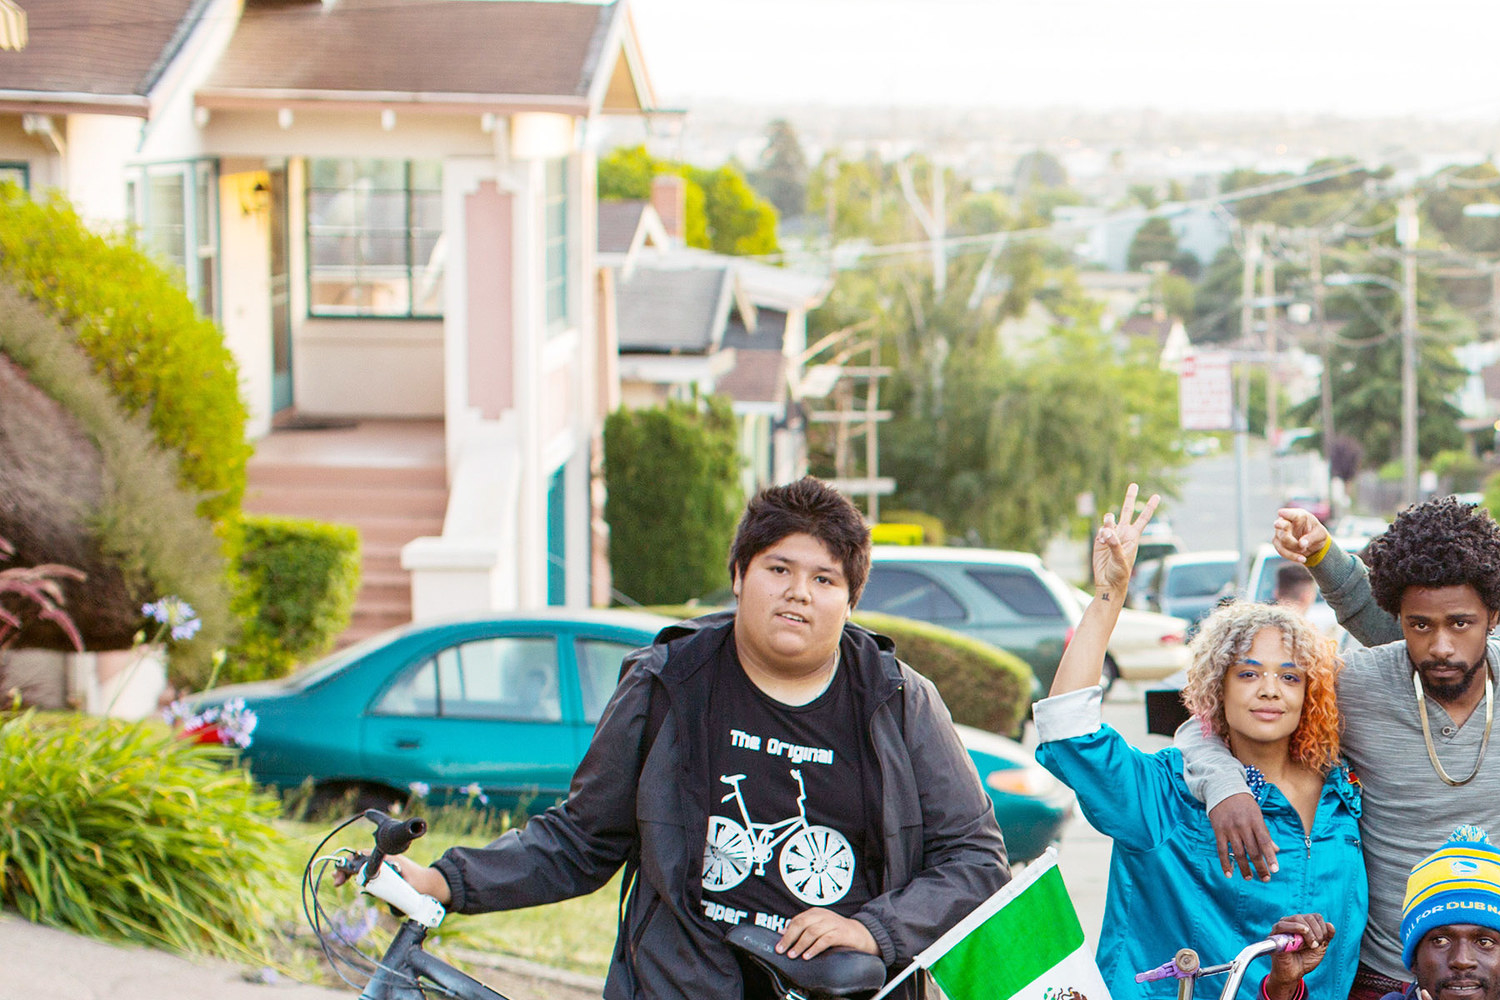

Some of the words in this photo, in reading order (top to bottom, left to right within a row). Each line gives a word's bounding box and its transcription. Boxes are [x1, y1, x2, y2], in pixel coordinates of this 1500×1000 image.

[730, 729, 762, 751] The
[767, 738, 835, 765] Original
[1416, 905, 1445, 923] FOR
[1446, 901, 1486, 911] DUB
